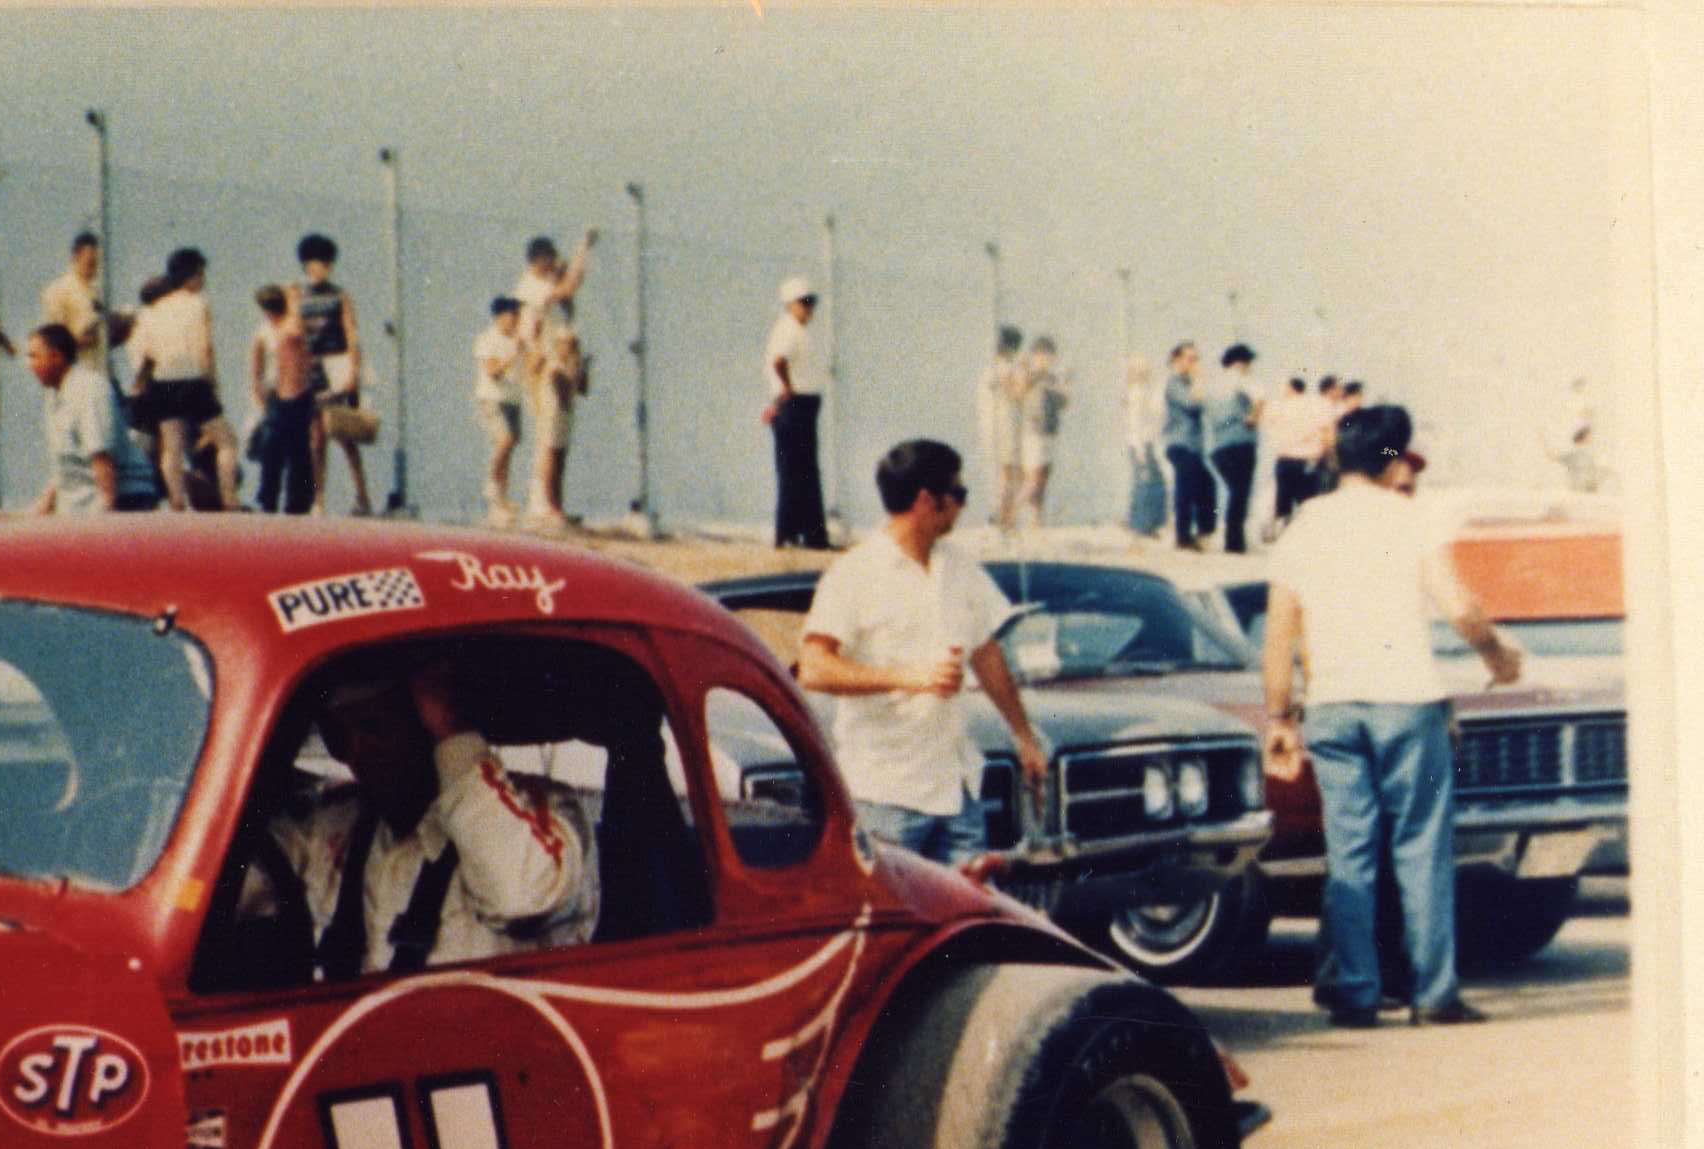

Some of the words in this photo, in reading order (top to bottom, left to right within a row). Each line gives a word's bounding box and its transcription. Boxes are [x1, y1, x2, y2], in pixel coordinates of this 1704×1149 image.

[277, 579, 373, 624] PURE
[414, 550, 566, 615] Ray
[12, 1035, 129, 1112] STP
